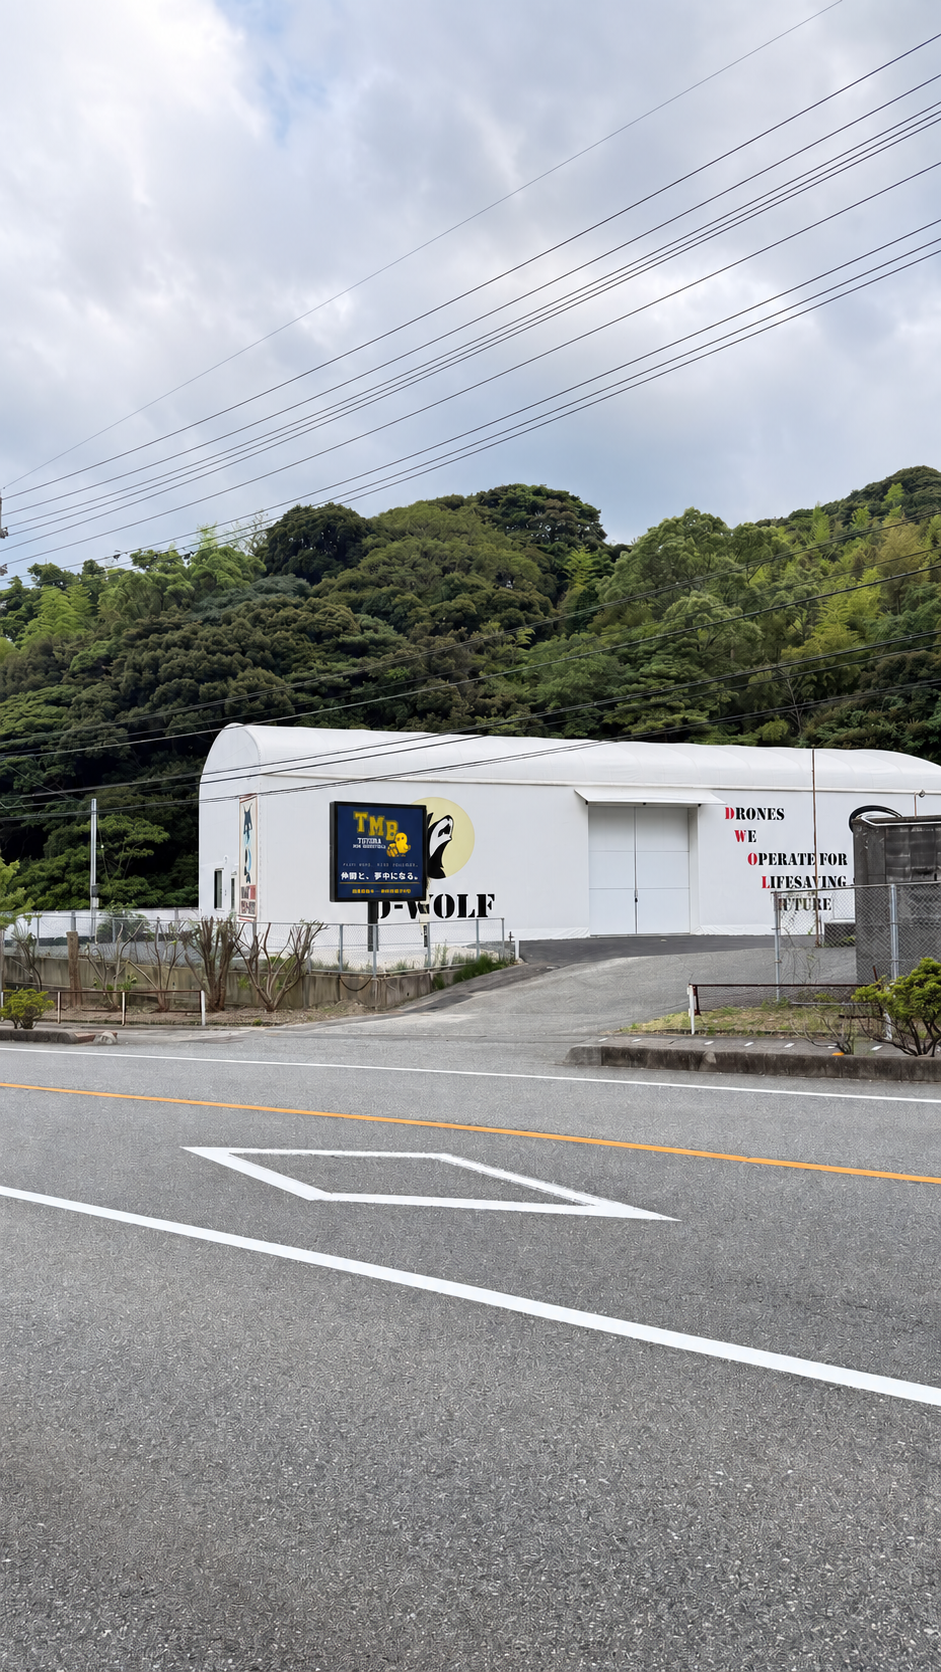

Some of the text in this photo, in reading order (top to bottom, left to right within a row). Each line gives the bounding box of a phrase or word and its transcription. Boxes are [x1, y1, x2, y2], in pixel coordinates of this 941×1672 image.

[725, 807, 785, 821] DRONES
[353, 811, 398, 841] TMB
[734, 830, 757, 843] WE
[747, 852, 848, 866] OPERATE FOR
[761, 875, 847, 889] LIFESAVING
